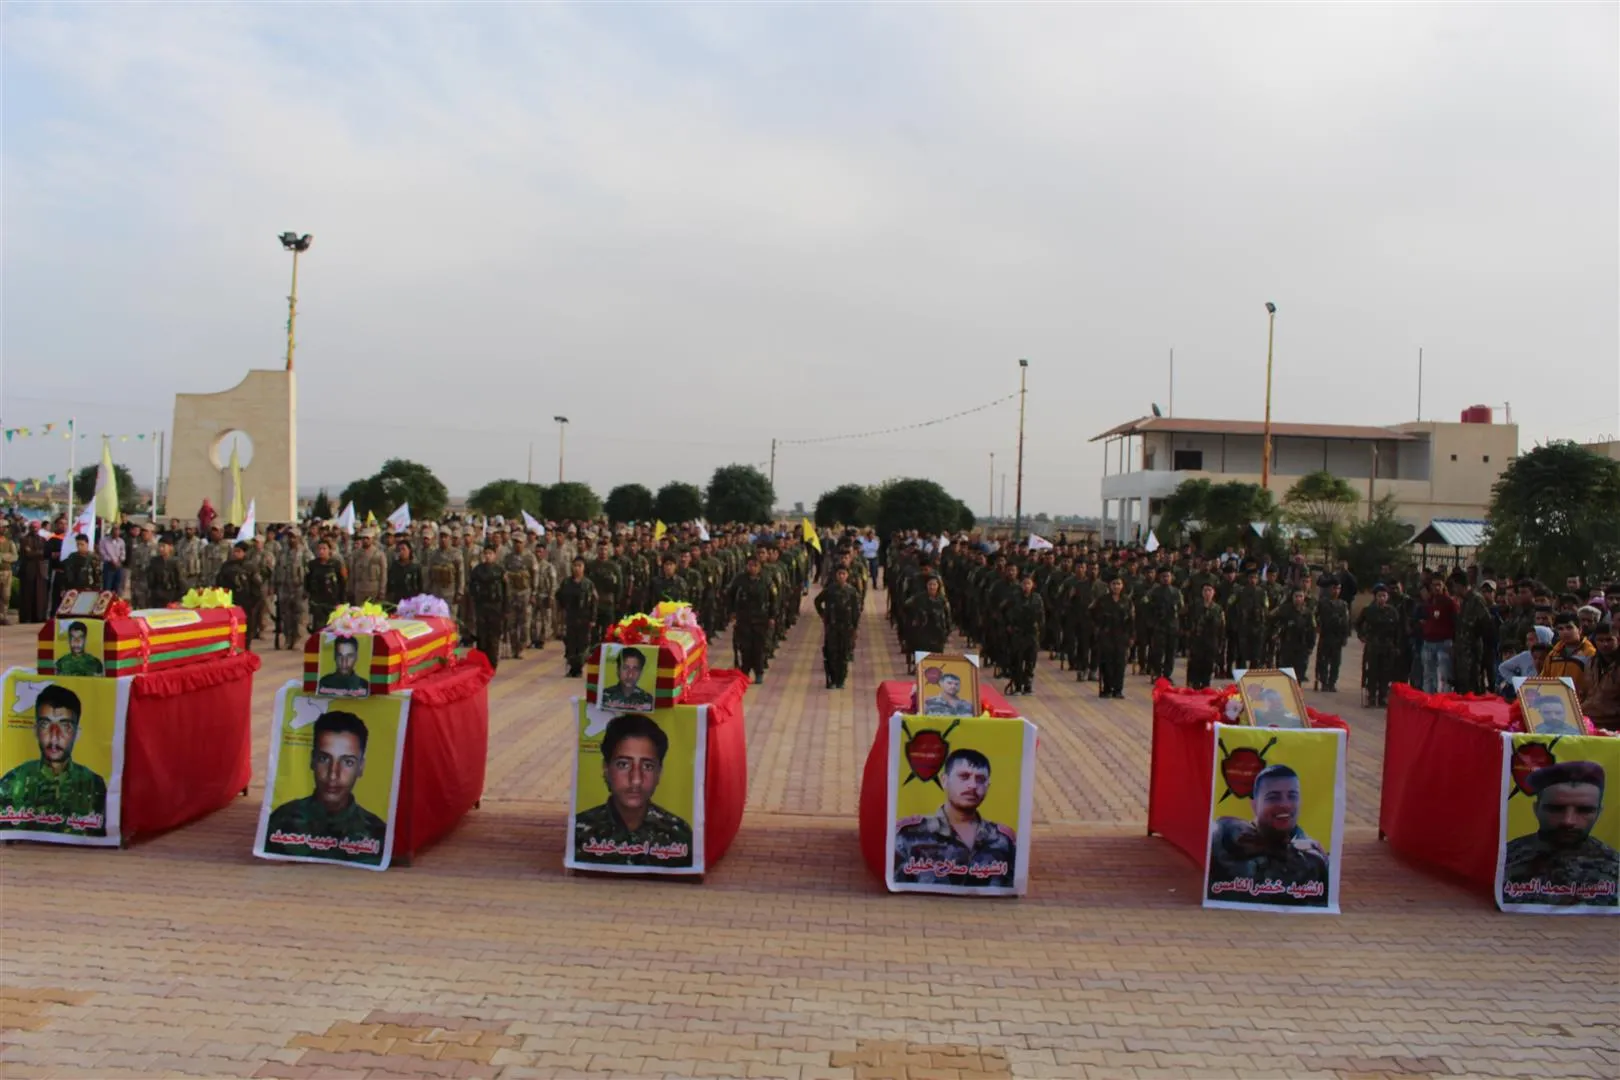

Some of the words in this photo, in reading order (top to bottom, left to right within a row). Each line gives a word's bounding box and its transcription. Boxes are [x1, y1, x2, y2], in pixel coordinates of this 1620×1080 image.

[36, 810, 64, 824] حمد
[67, 811, 104, 830] الشهيد
[270, 829, 305, 845] محمد
[339, 836, 380, 855] الشهيد
[583, 837, 617, 856] خليف
[617, 840, 650, 855] احمد
[650, 842, 689, 859] الشهيد
[903, 856, 935, 875] خليل
[934, 858, 969, 877] صلاح
[969, 860, 1008, 879] الشهيد
[1251, 878, 1286, 896] خضر
[1286, 880, 1324, 899] الشهيد
[1541, 880, 1576, 896] احمد
[1576, 880, 1616, 899] الشهيد
